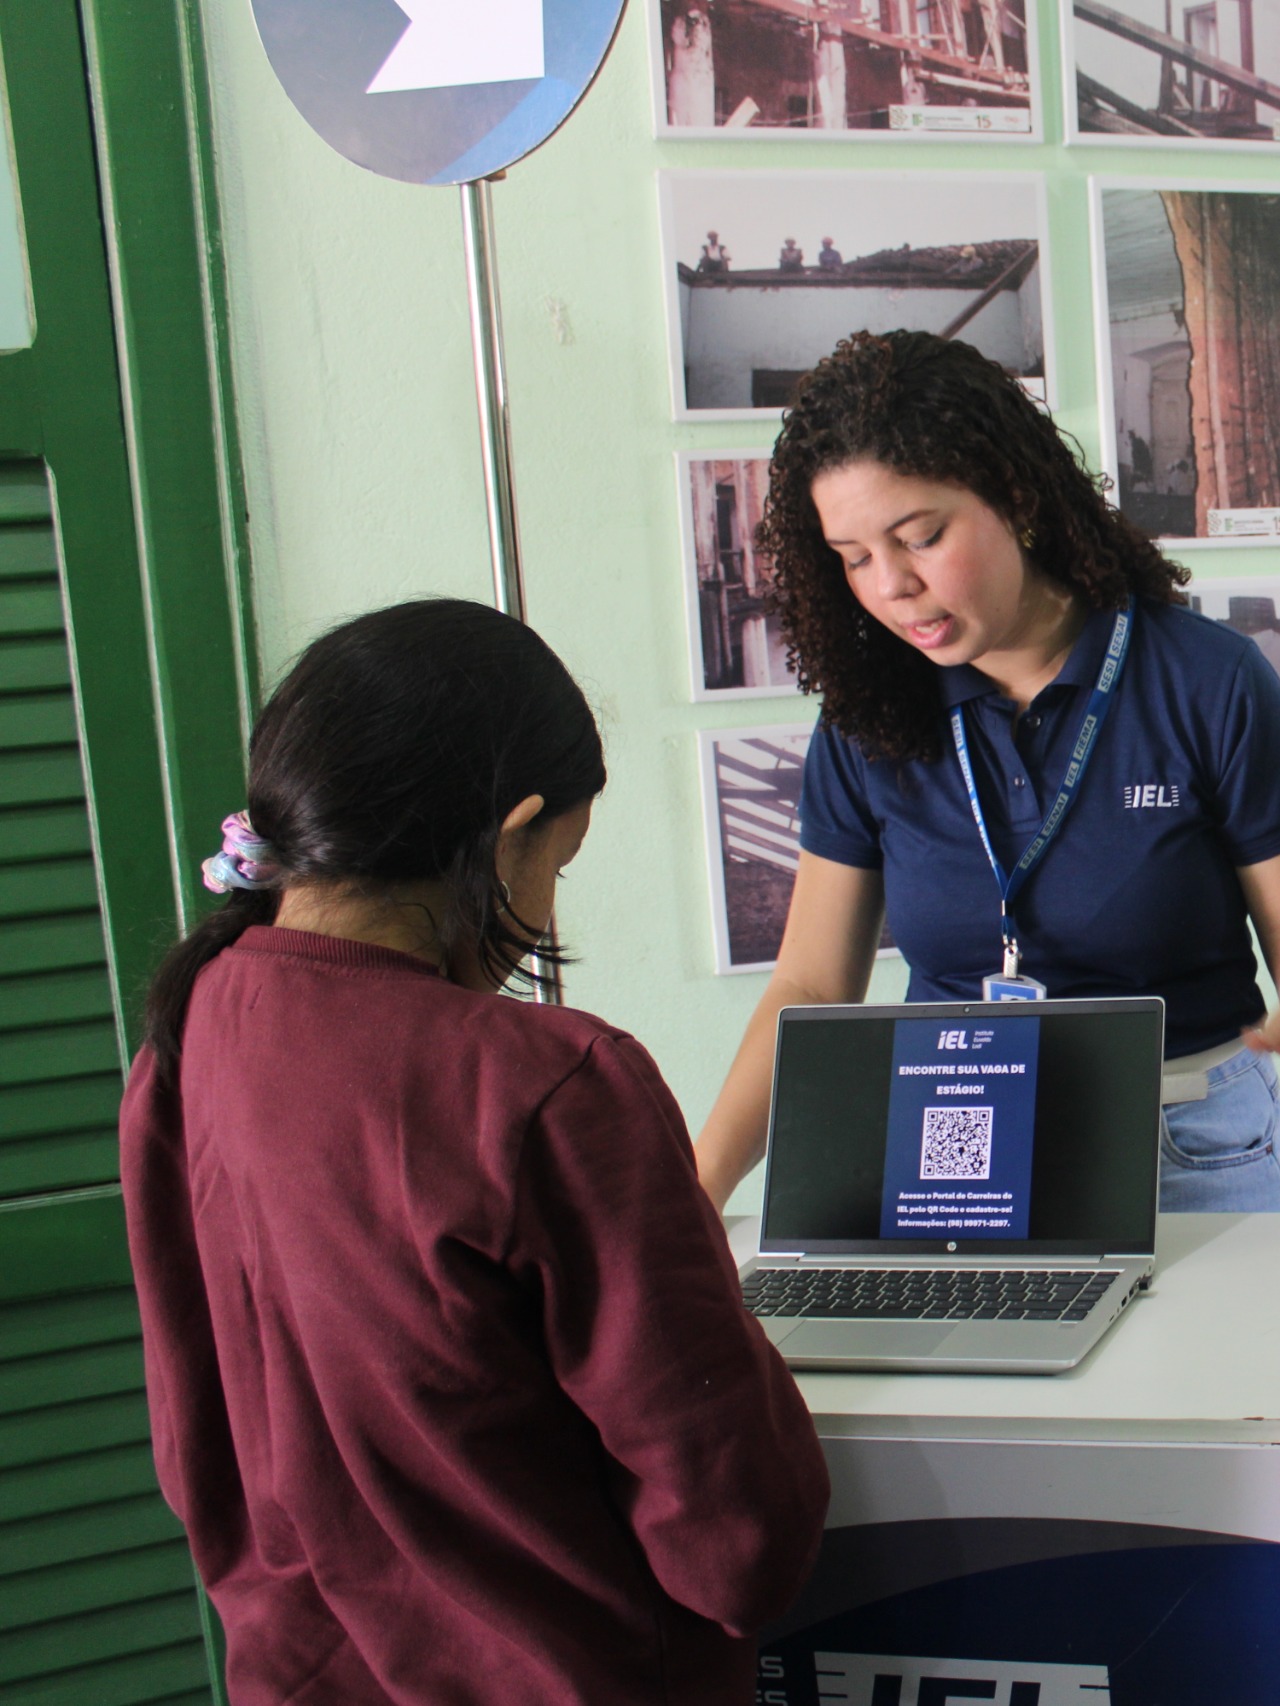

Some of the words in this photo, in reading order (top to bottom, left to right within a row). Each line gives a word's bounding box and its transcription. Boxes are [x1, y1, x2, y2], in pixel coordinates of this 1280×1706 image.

[1100, 662, 1116, 691] SESI
[1111, 617, 1128, 655] SENAI
[1043, 795, 1067, 835] SENAI
[1066, 764, 1078, 785] IEL
[1075, 718, 1095, 757] FIEMA
[1132, 784, 1173, 809] IEL
[898, 1065, 956, 1076] ENCONTRE
[957, 1065, 980, 1075] SUA
[980, 1064, 1009, 1074] VAGA
[1010, 1064, 1026, 1074] DE
[936, 1083, 985, 1095] ESTÁGIO!
[899, 1192, 926, 1200] Acesse
[932, 1192, 955, 1200] Portal
[967, 1192, 1001, 1200] Carreiras
[897, 1205, 909, 1213] IEL
[909, 1206, 926, 1215] pelo
[927, 1205, 938, 1214] QR
[939, 1205, 959, 1213] Code
[966, 1205, 1013, 1213] cadastre-se!
[897, 1219, 946, 1228] Informações:
